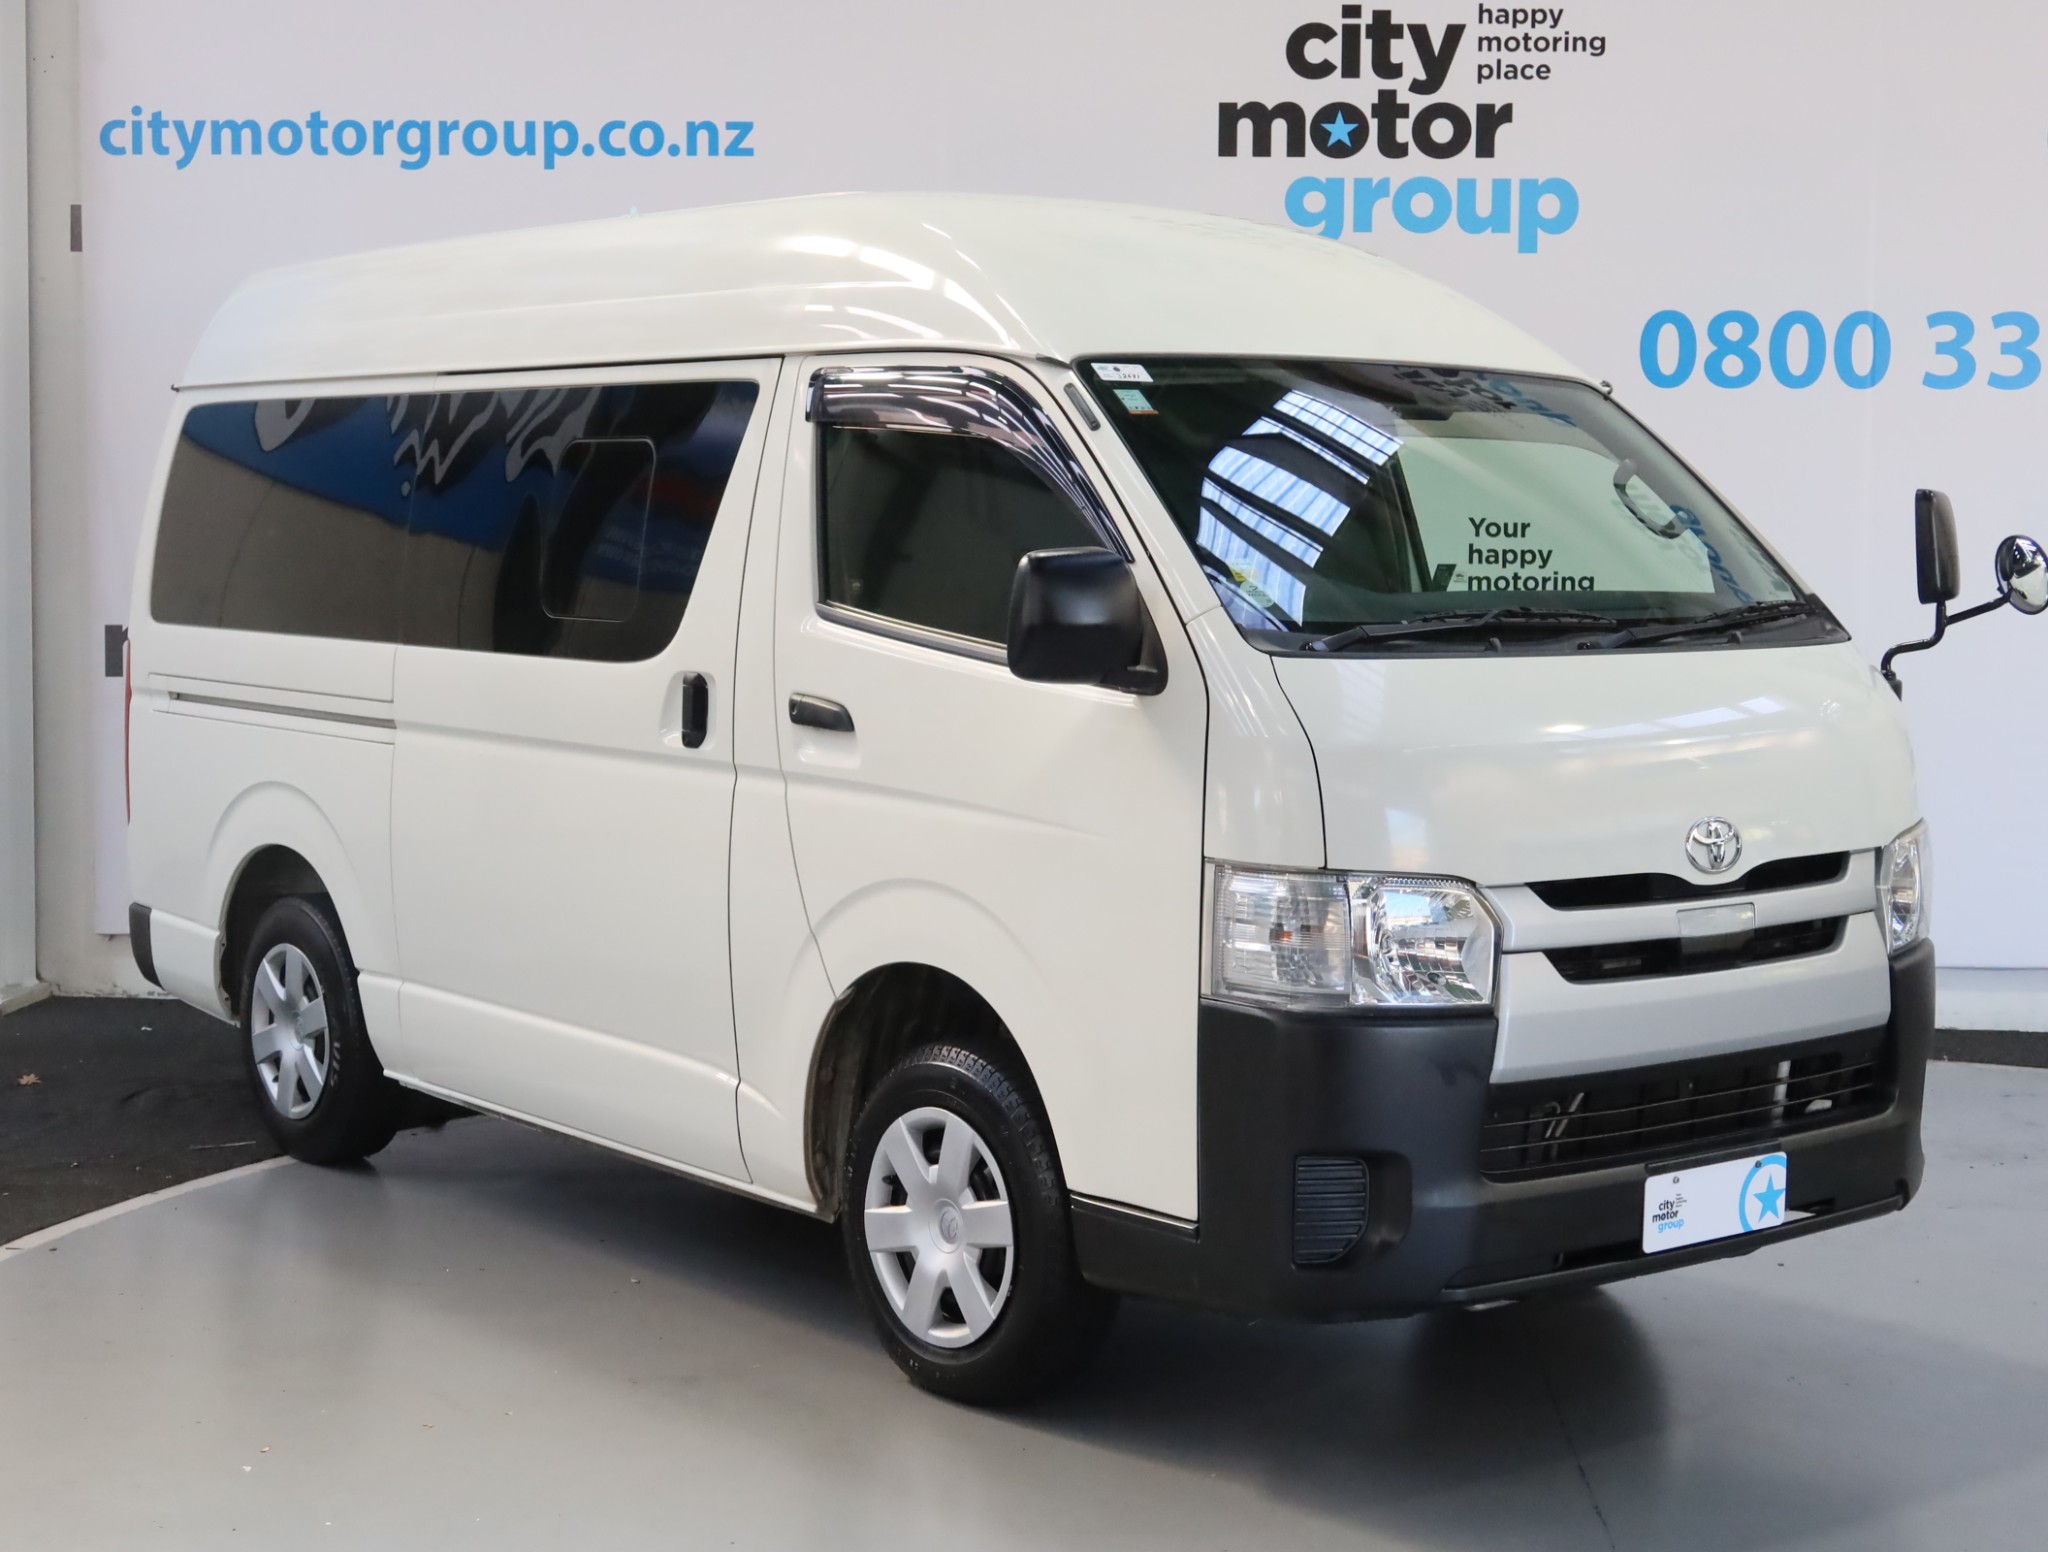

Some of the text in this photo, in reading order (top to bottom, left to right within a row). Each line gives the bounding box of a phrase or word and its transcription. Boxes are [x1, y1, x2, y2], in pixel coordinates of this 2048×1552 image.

[1478, 3, 1563, 29] happy
[1286, 4, 1466, 95] city
[1478, 31, 1606, 57] motoring
[1477, 58, 1551, 84] place
[1218, 89, 1513, 159] motor
[100, 105, 754, 170] citymotorgroup.co.nz
[1284, 176, 1579, 254] group
[1640, 310, 2041, 391] 0800 33
[1468, 517, 1531, 538] Your
[1468, 543, 1553, 569] happy
[1652, 1210, 1679, 1223] motor
[1658, 1199, 1675, 1211] city
[1658, 1218, 1685, 1233] group
